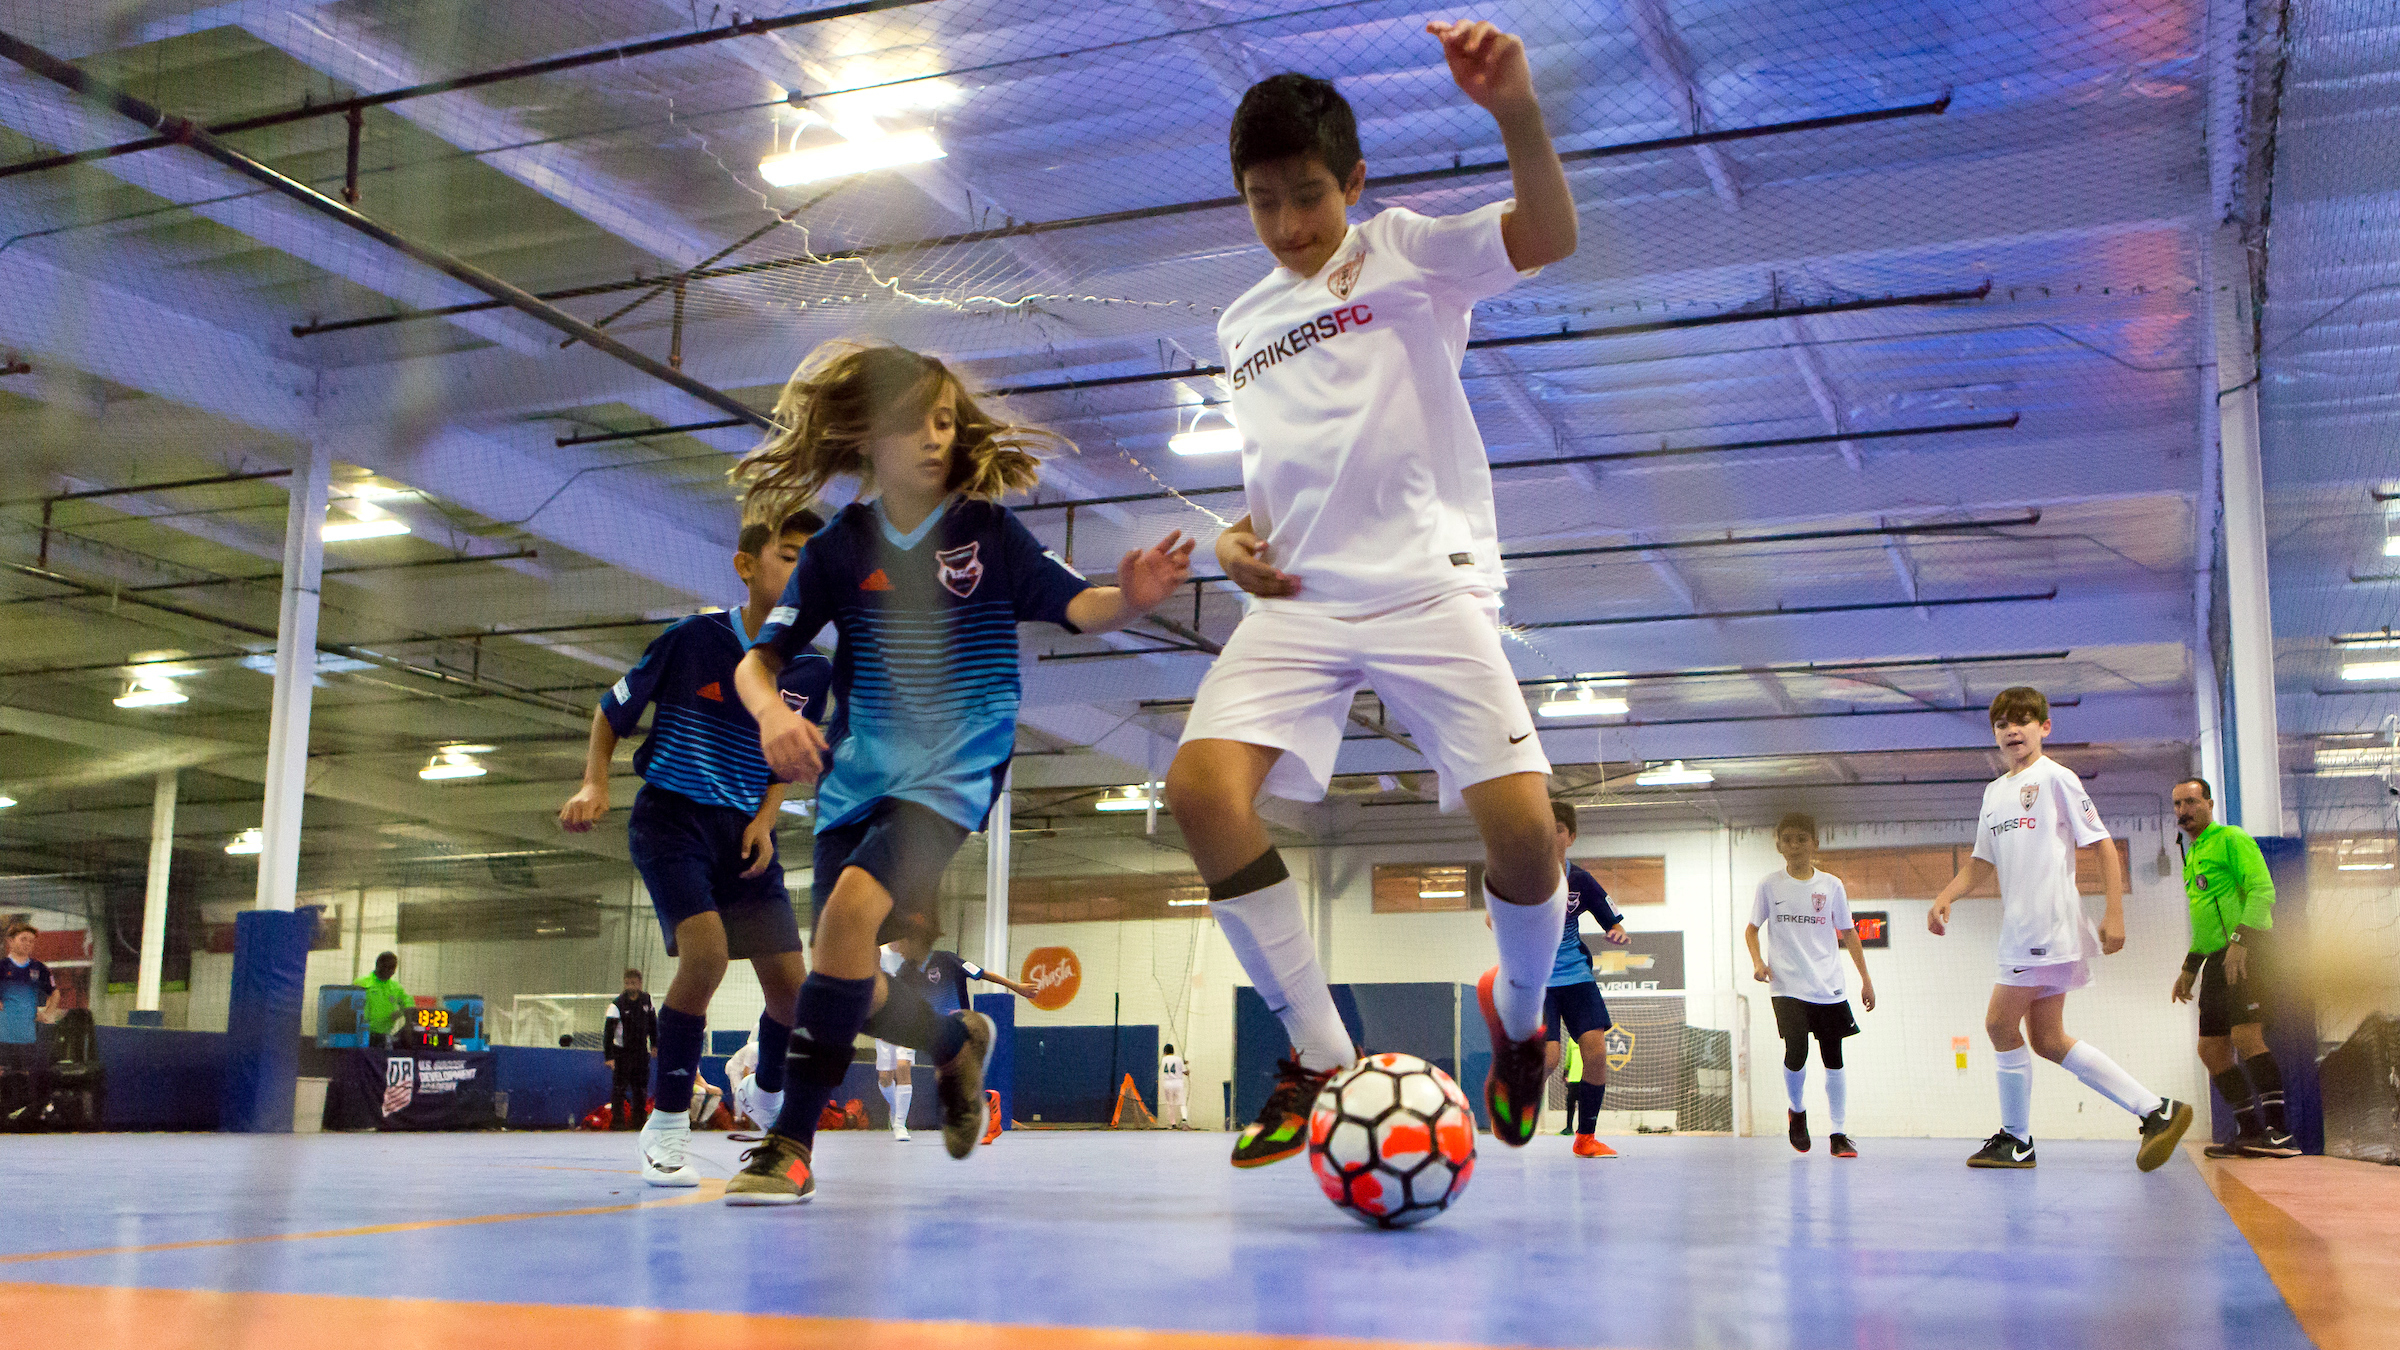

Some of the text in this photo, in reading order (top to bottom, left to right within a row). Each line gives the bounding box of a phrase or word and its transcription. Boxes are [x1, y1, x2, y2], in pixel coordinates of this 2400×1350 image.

[1233, 304, 1373, 390] STRIKERSFC
[1029, 957, 1076, 990] Shasta
[418, 1009, 449, 1028] 13:23
[1606, 1040, 1627, 1054] LA
[1163, 1063, 1176, 1075] 44
